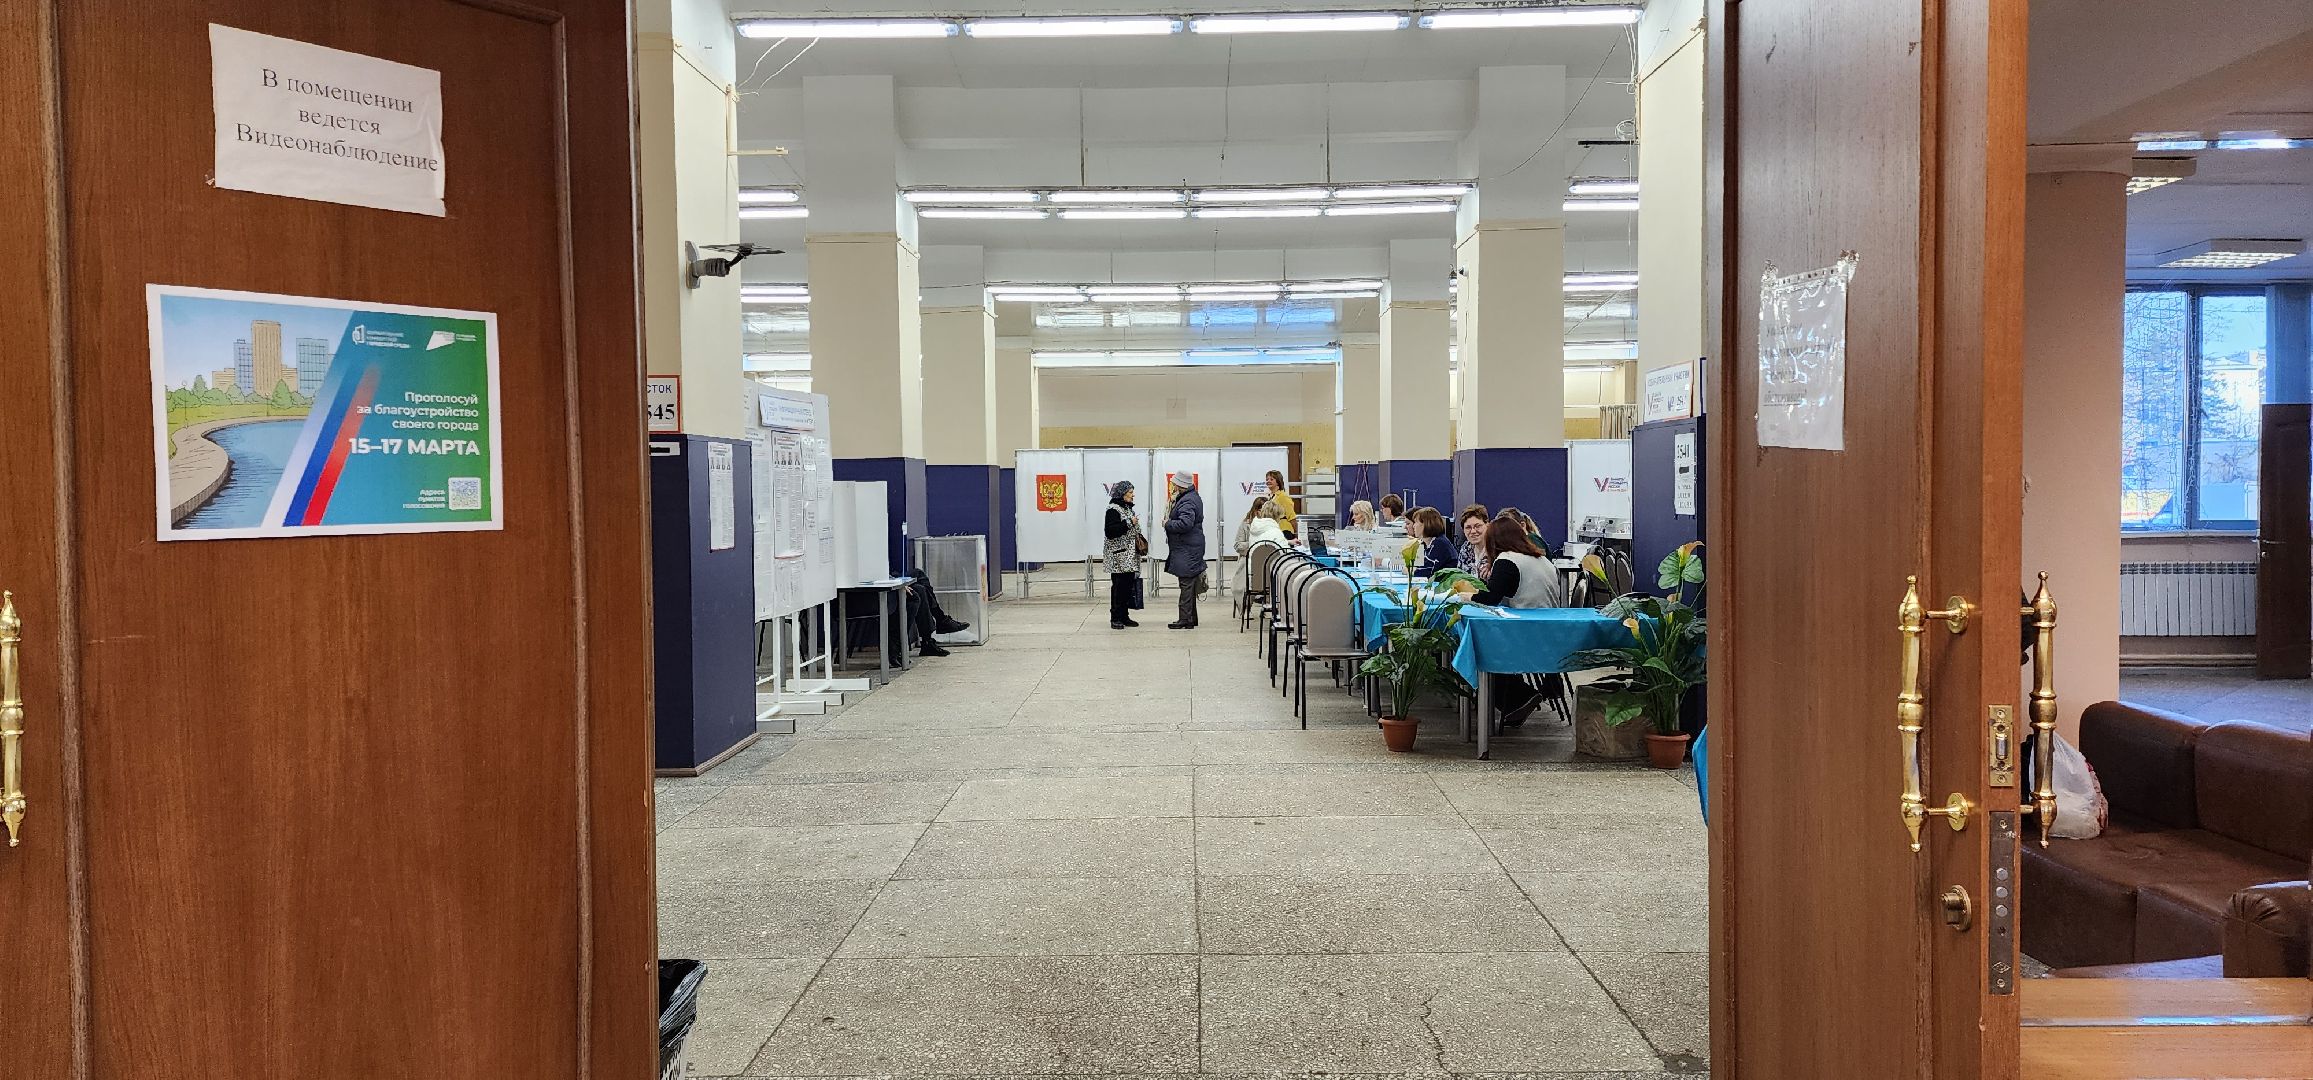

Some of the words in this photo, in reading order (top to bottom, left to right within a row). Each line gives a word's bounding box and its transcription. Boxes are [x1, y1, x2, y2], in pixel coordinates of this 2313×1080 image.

[261, 68, 279, 88] В
[287, 77, 414, 114] помещении
[298, 109, 381, 135] ведется
[236, 122, 439, 172] Видеонаблюдение
[404, 391, 479, 406] Проголосуй
[356, 405, 372, 414] за
[374, 403, 479, 418] благоустройство
[391, 420, 435, 429] своего
[437, 421, 479, 431] города
[407, 439, 480, 456] МАРТА
